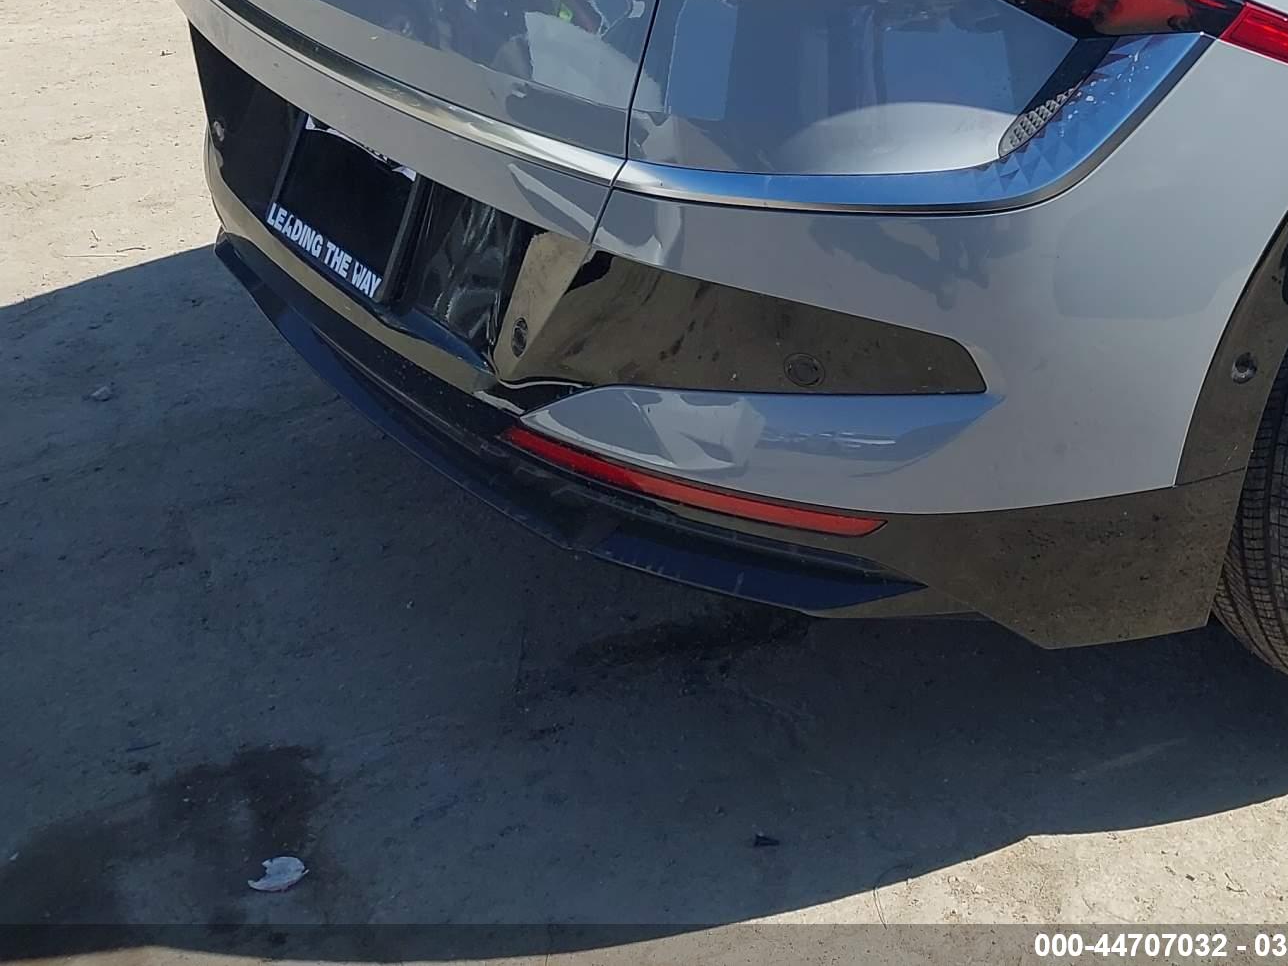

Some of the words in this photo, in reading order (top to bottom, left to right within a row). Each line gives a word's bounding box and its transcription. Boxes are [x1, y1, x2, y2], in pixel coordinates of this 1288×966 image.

[266, 202, 324, 257] LEADING
[323, 241, 353, 279] THE
[351, 261, 382, 299] WAY
